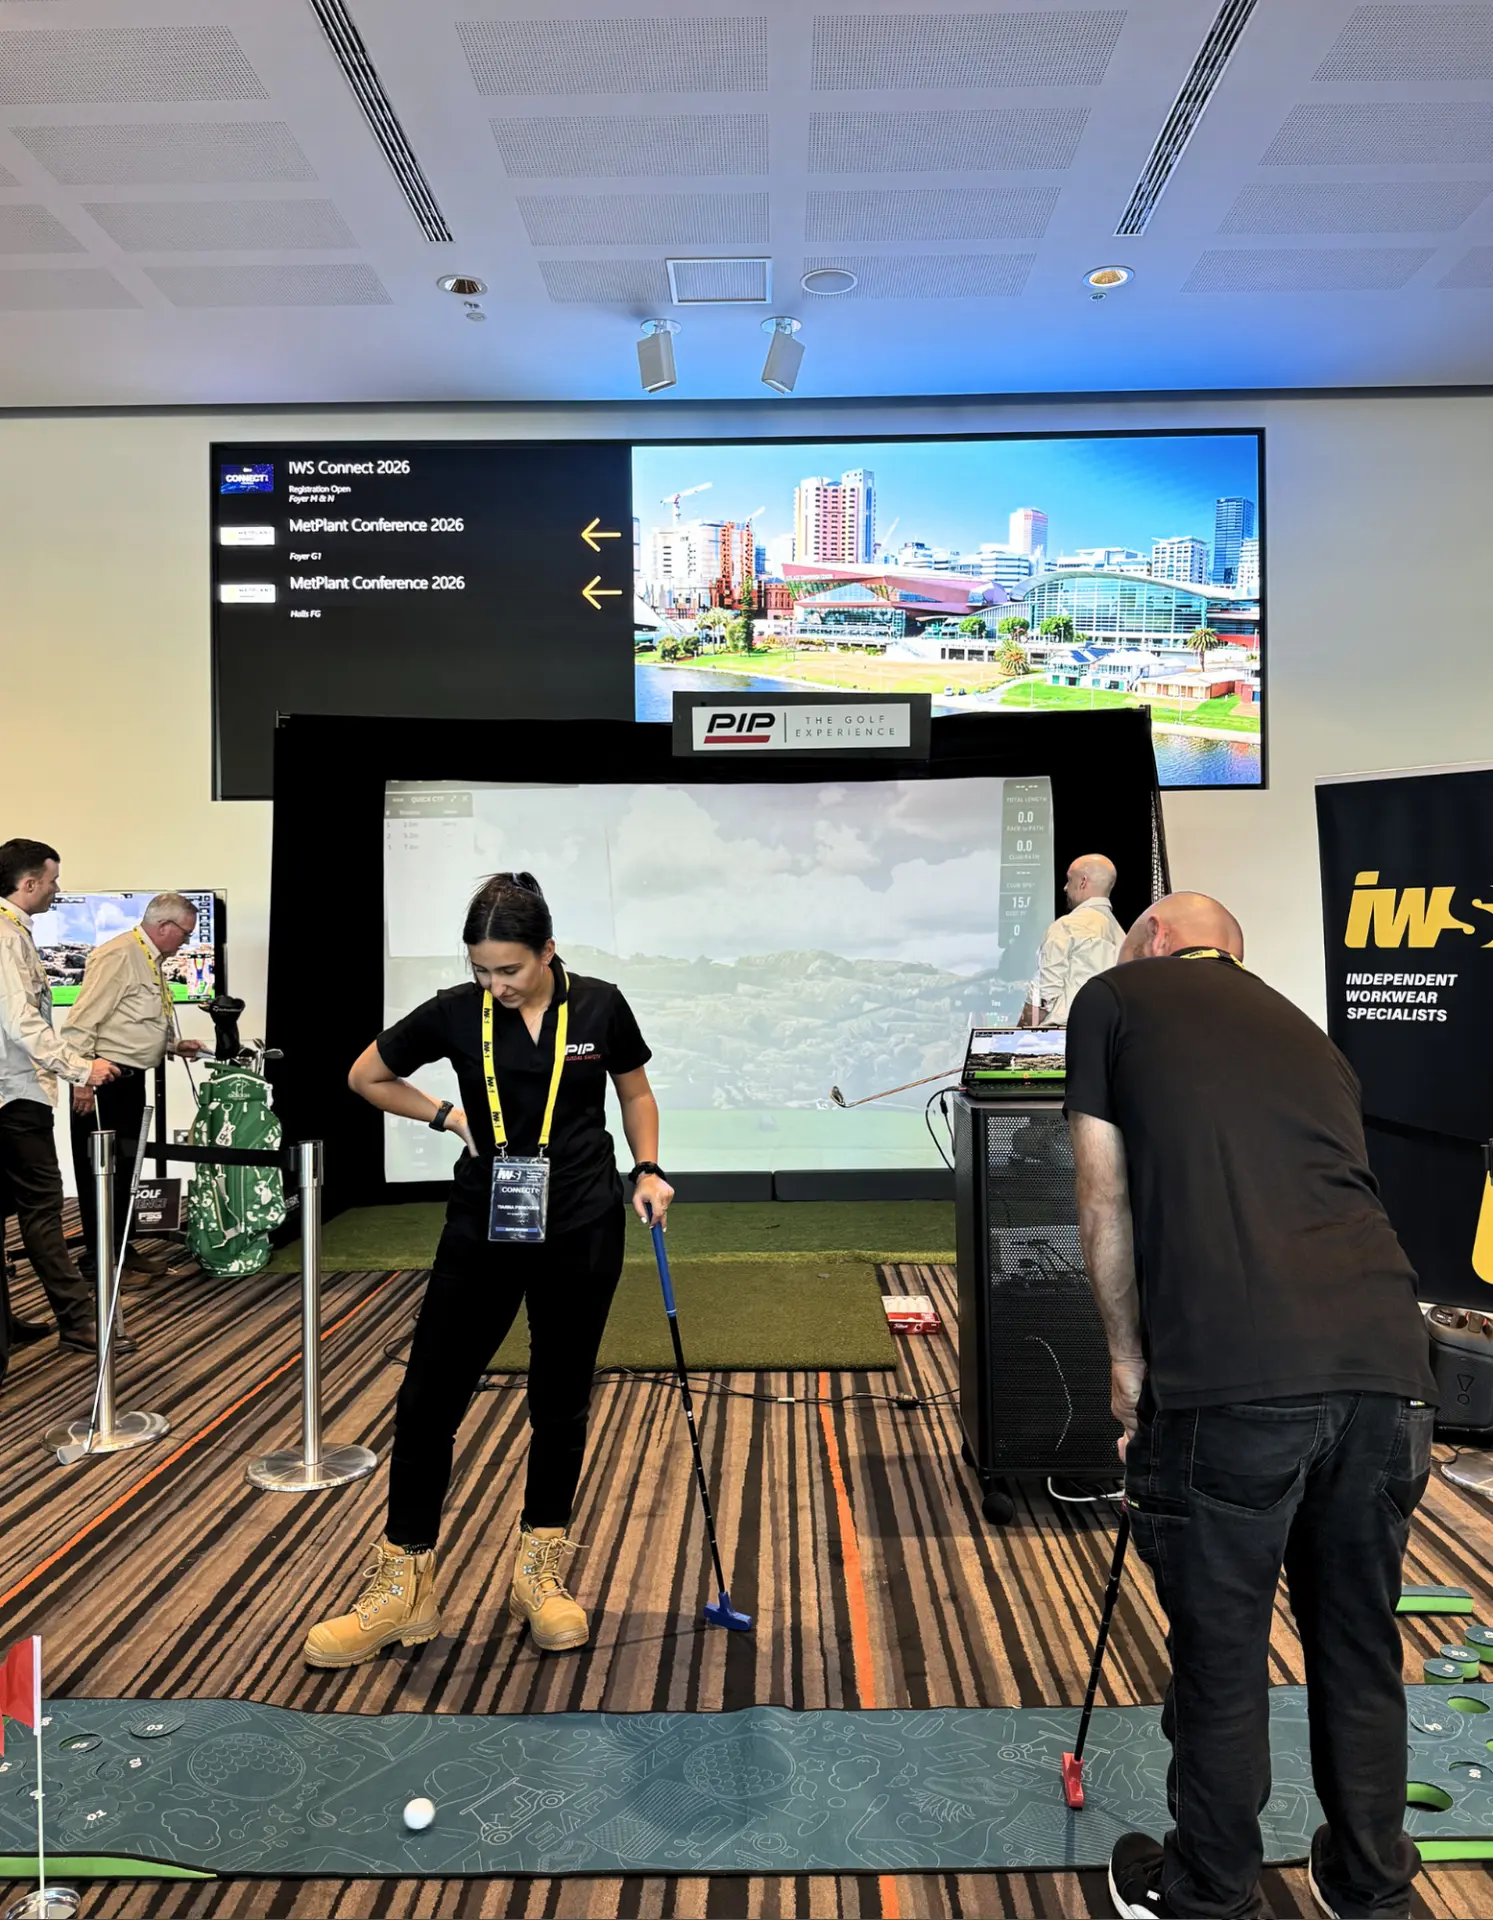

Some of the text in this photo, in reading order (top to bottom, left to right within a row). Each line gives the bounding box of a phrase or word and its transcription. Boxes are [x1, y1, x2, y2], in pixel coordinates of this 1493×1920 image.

[288, 460, 410, 474] IWS Connect 2026
[289, 485, 351, 494] Registration Open
[289, 495, 309, 504] Foyer
[289, 518, 464, 532] MetPlant Conference 2026
[289, 552, 322, 562] Foyer G1
[290, 576, 465, 590] MetPlant Conference 2026
[310, 610, 322, 618] FG
[706, 712, 776, 733] PIP
[805, 714, 885, 725] THE GOLF
[795, 727, 895, 737] EXPERIENCE
[1017, 811, 1034, 823] 0.0
[1016, 840, 1032, 852] 0.0
[1013, 924, 1020, 936] 0
[1346, 973, 1458, 987] INDEPENDENT
[1346, 990, 1438, 1004] WORKWEAR
[1346, 1007, 1448, 1022] SPECIALISTS
[565, 1043, 595, 1055] PIP
